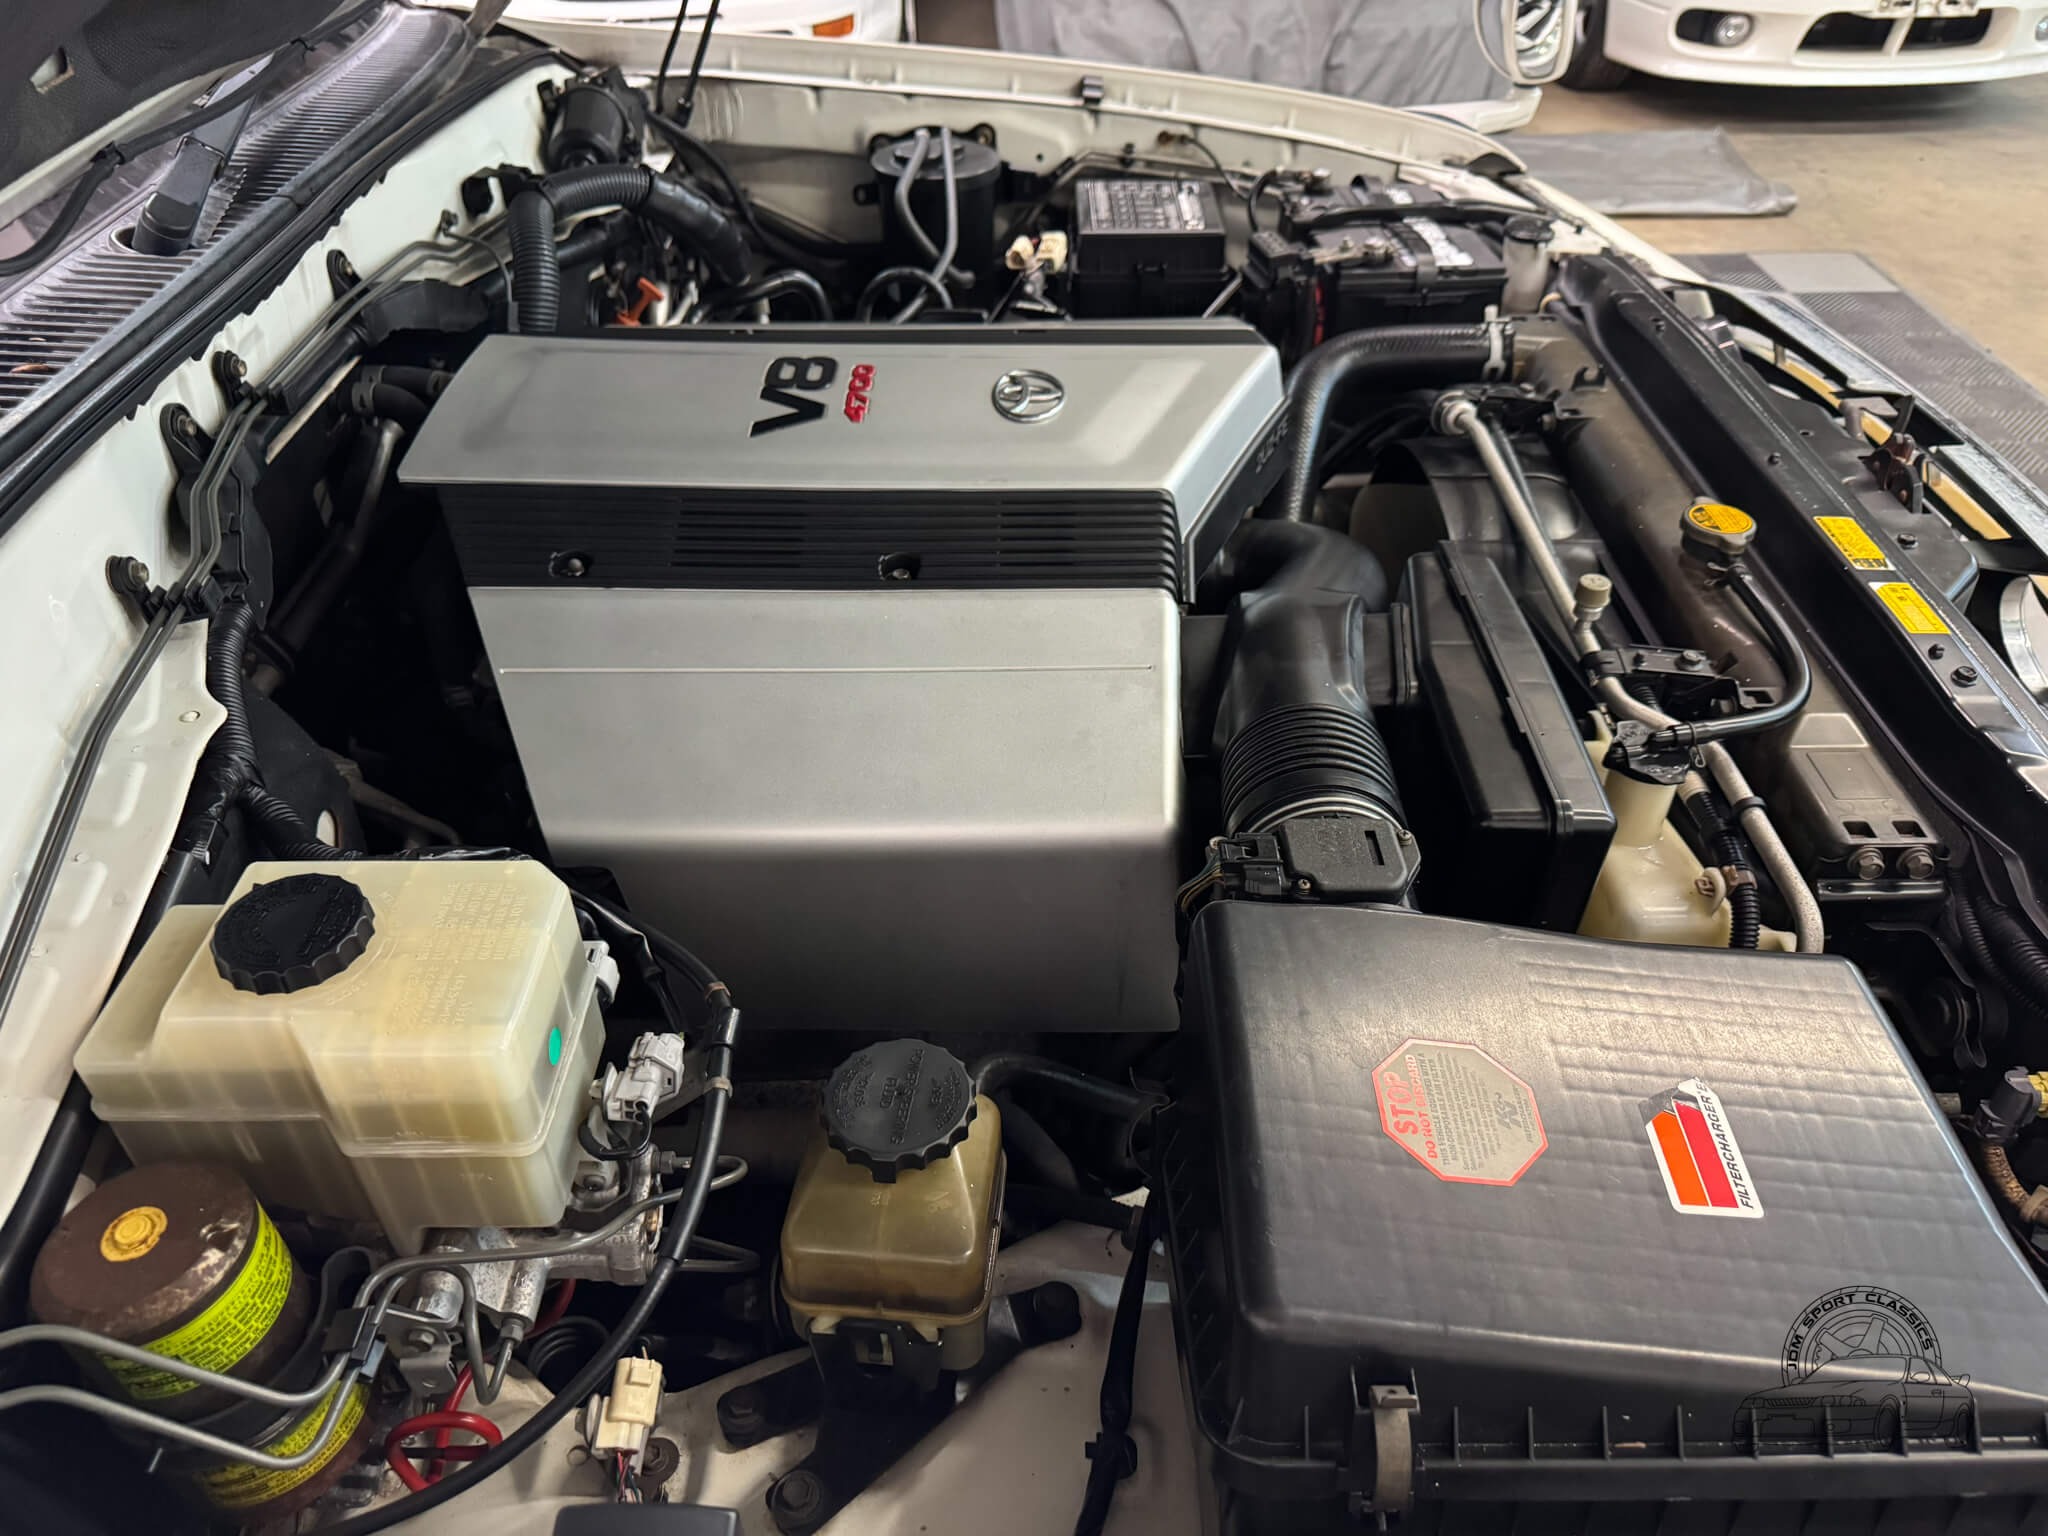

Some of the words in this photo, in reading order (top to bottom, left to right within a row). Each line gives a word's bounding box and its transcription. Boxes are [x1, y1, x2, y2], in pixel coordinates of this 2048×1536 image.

[750, 356, 839, 438] V8
[844, 363, 877, 424] 4700
[879, 1077, 899, 1109] FLUID
[902, 1048, 925, 1086] POWER
[1404, 1054, 1426, 1107] DISCARD
[889, 1087, 916, 1144] STEERING
[1383, 1071, 1418, 1135] STOP
[1418, 1112, 1433, 1137] NOT
[1424, 1139, 1438, 1159] DO
[1432, 1115, 1446, 1145] VEHICLE
[1701, 1094, 1754, 1210] FILTERCHARGER
